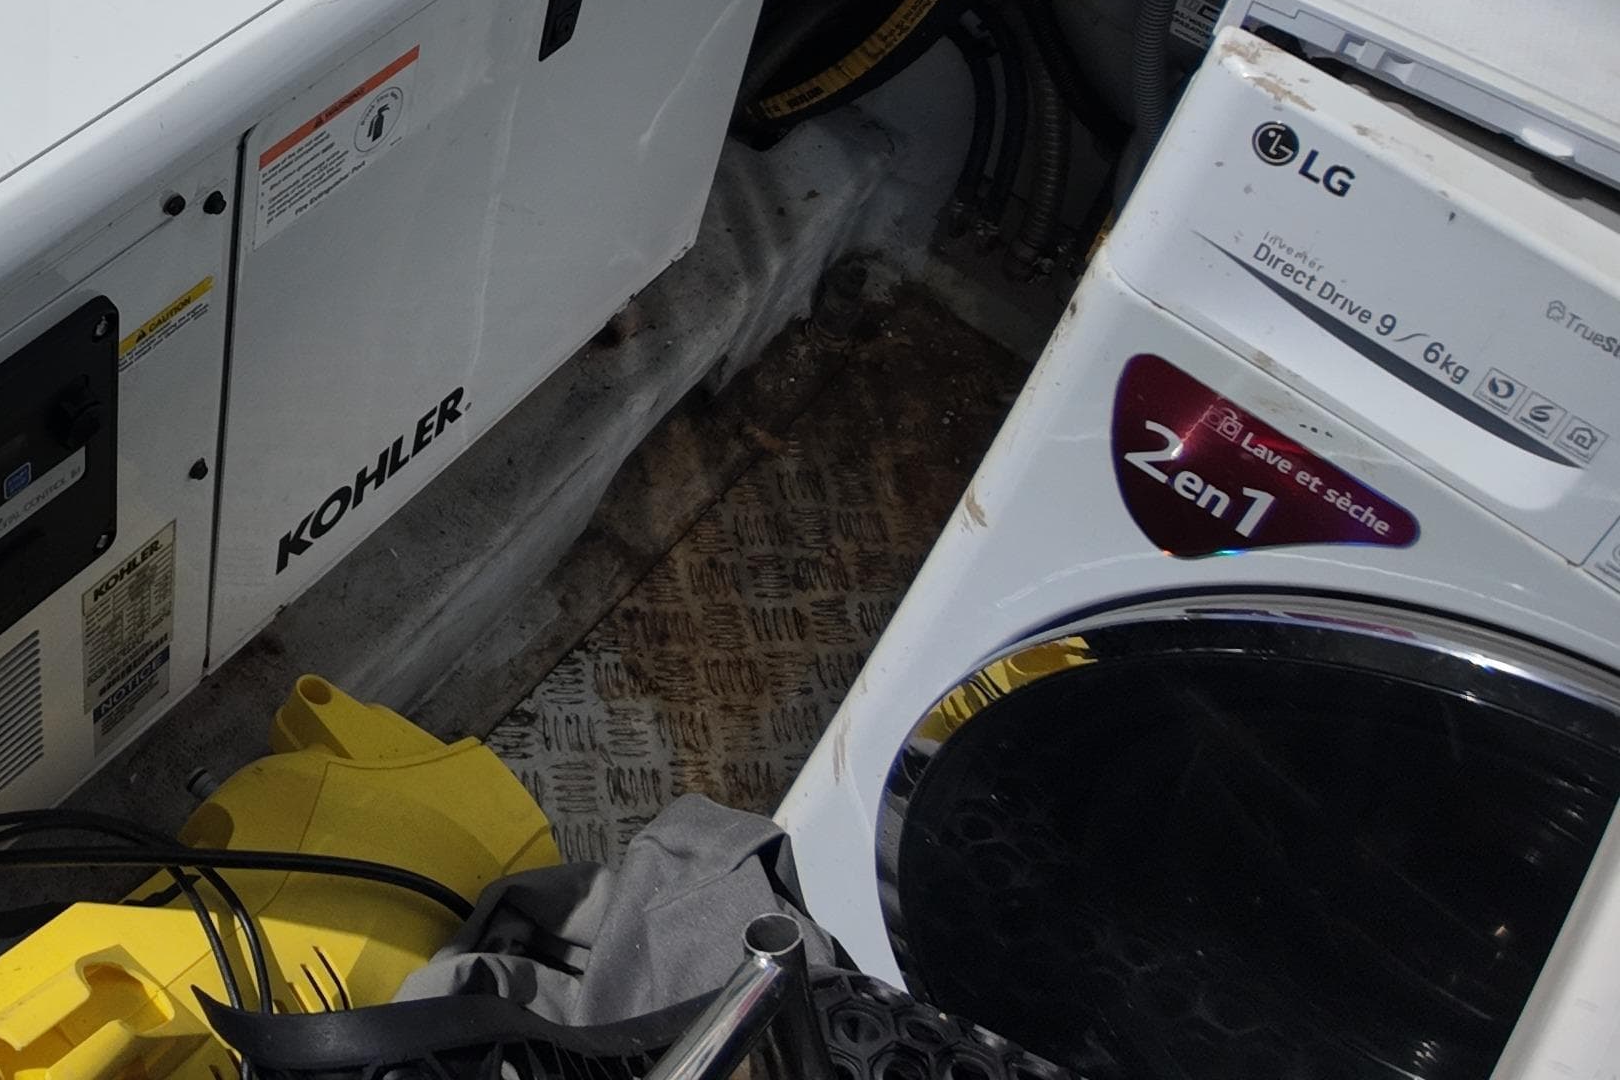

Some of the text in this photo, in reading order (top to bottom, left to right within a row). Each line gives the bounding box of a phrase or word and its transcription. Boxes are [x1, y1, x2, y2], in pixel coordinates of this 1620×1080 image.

[1298, 149, 1356, 198] LG
[148, 295, 192, 334] CAUTION
[1253, 242, 1317, 291] Direct
[1317, 280, 1373, 324] Drive
[276, 386, 465, 576] KOHLER
[1241, 432, 1391, 535] Lave et sèche
[93, 539, 161, 602] KOHLER
[101, 653, 166, 715] NOTICE
